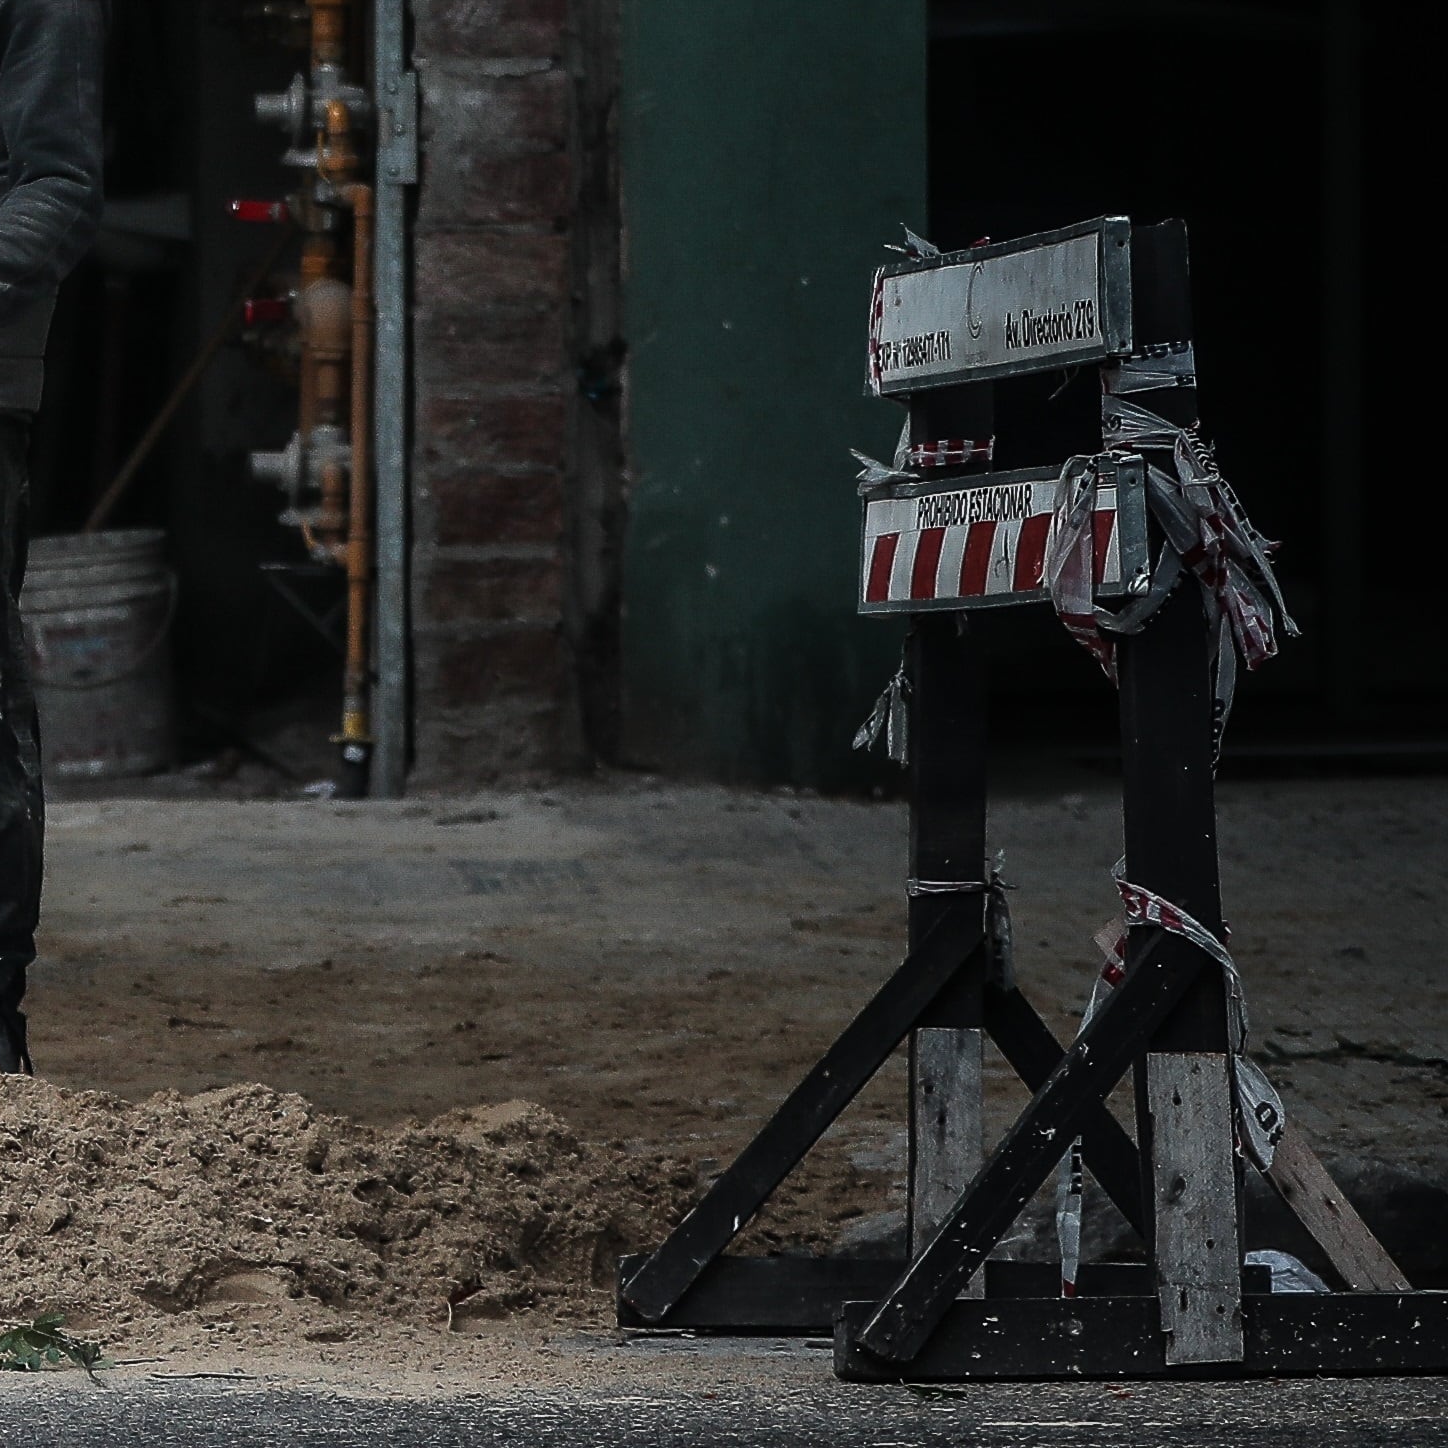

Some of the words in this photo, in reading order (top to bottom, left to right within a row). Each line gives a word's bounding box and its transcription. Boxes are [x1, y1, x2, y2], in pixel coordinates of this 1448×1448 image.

[1005, 311, 1021, 349] Av.
[1021, 302, 1073, 347] Directorio
[1073, 299, 1095, 340] 279
[916, 492, 968, 530] PROHIBIDO
[968, 483, 1033, 524] ESTACIONAR
